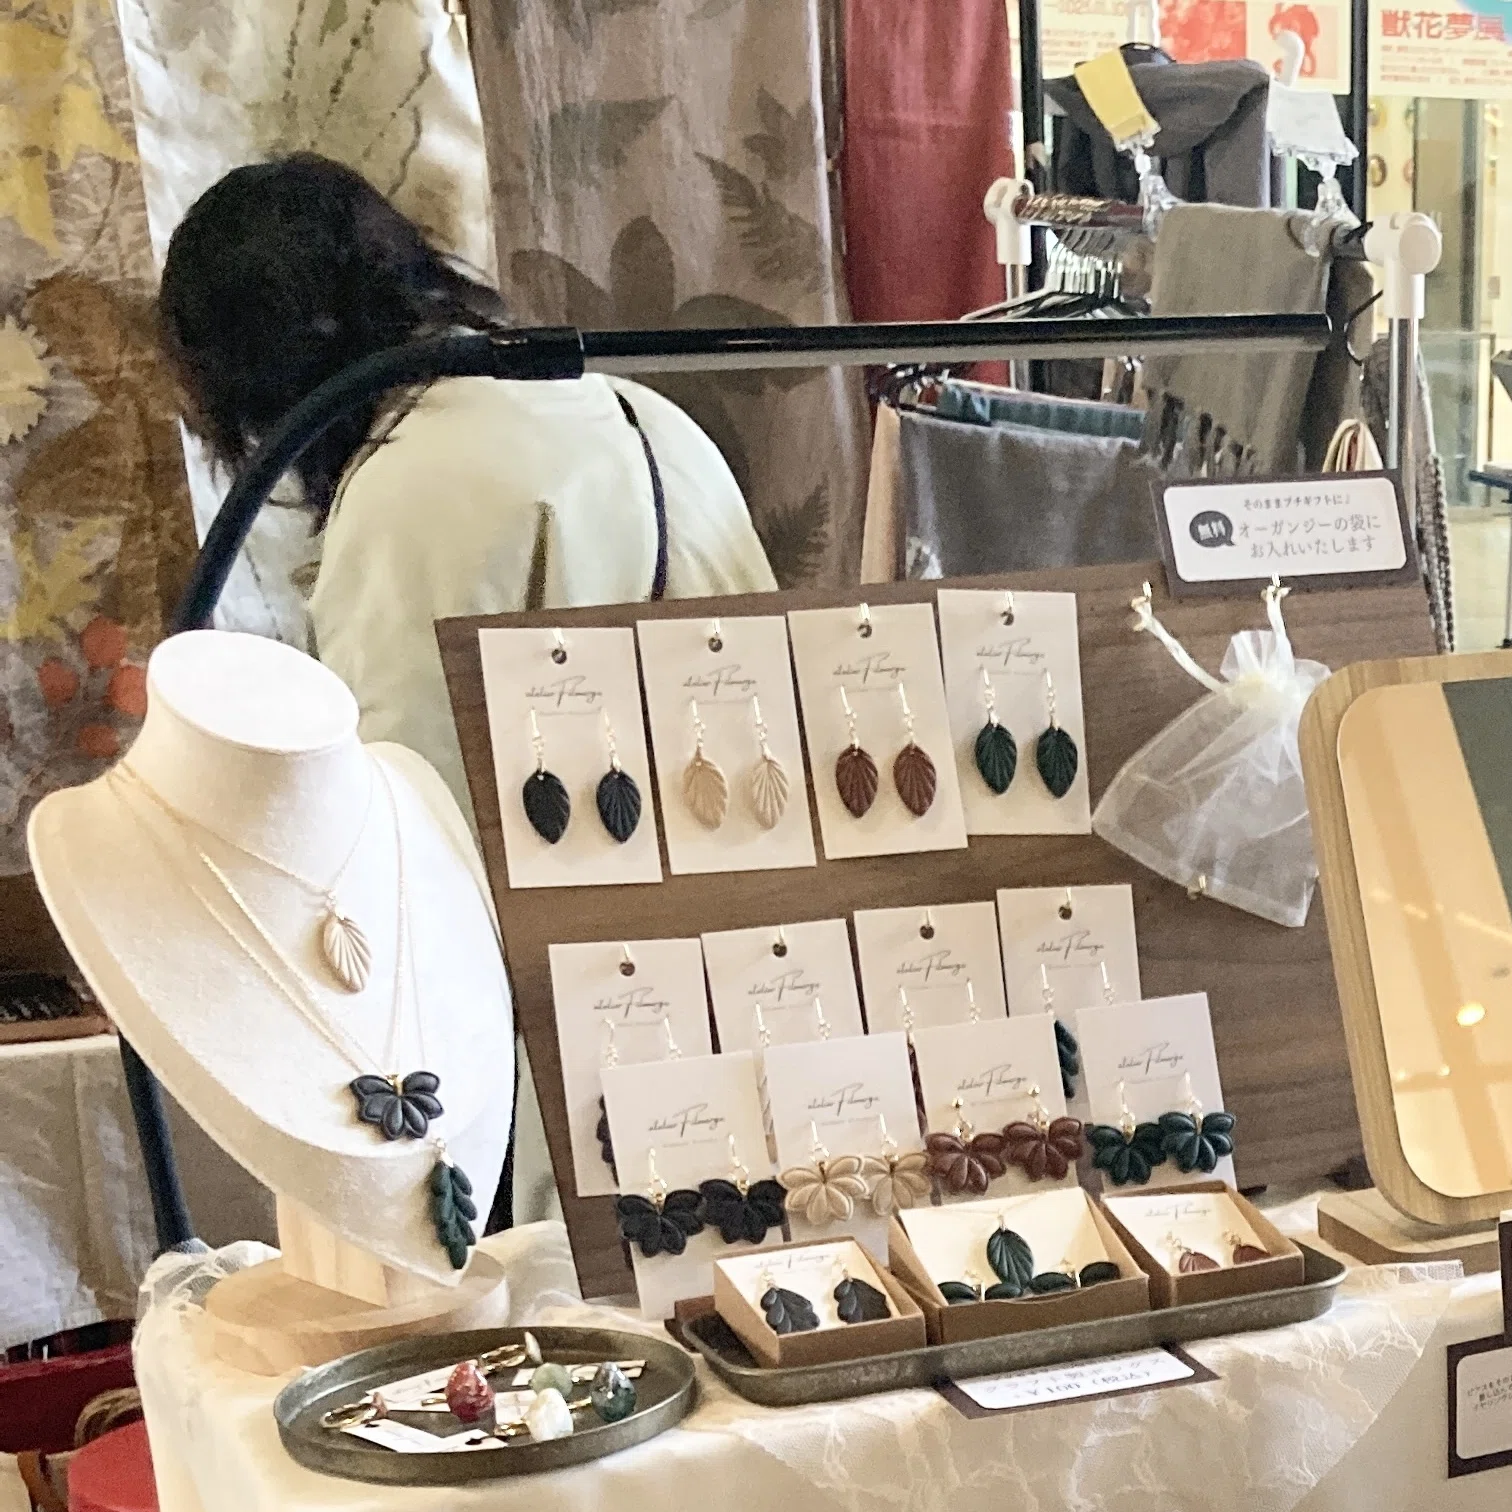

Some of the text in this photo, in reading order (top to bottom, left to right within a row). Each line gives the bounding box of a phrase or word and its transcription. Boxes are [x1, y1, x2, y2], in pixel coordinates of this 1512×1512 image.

[1239, 513, 1382, 538] オーガンジーの袋に
[1250, 535, 1376, 559] お入れいたします
